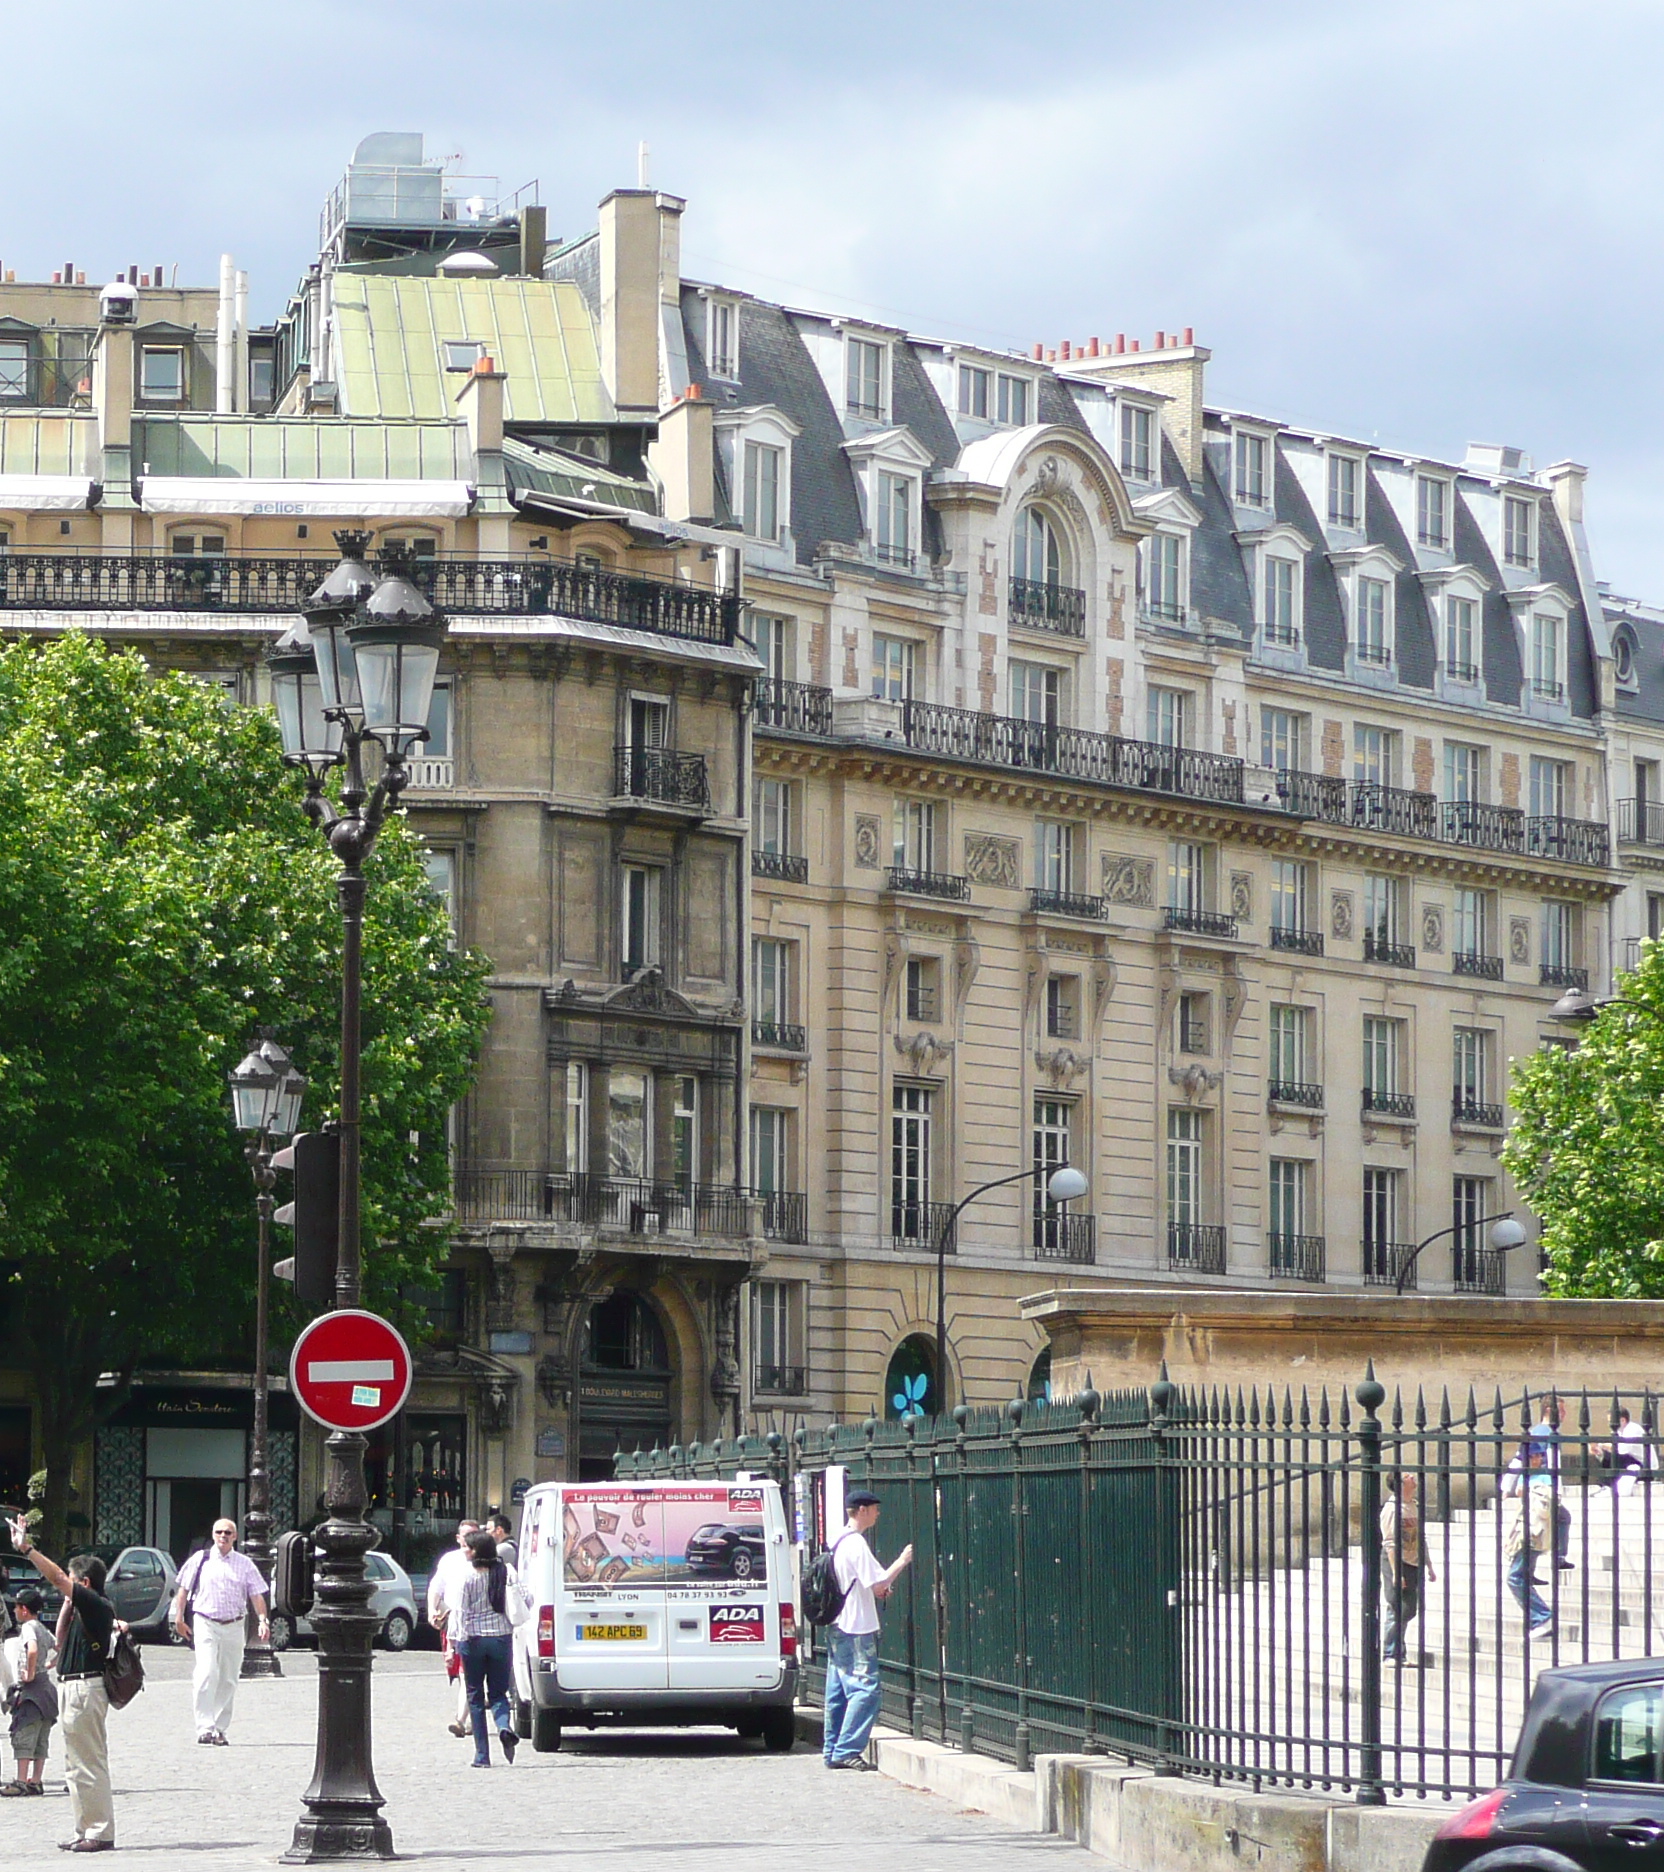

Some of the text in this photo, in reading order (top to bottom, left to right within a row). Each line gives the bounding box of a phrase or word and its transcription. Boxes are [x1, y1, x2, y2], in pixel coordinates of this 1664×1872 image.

[253, 501, 304, 513] aelios
[587, 1493, 621, 1503] pouvoir
[623, 1493, 634, 1501] de
[666, 1493, 693, 1501] moins
[694, 1492, 714, 1501] cher
[730, 1489, 762, 1500] ADA
[617, 1593, 640, 1601] LYON
[667, 1591, 678, 1599] 04
[713, 1608, 760, 1621] ADA
[587, 1625, 643, 1638] 142 APC 69
